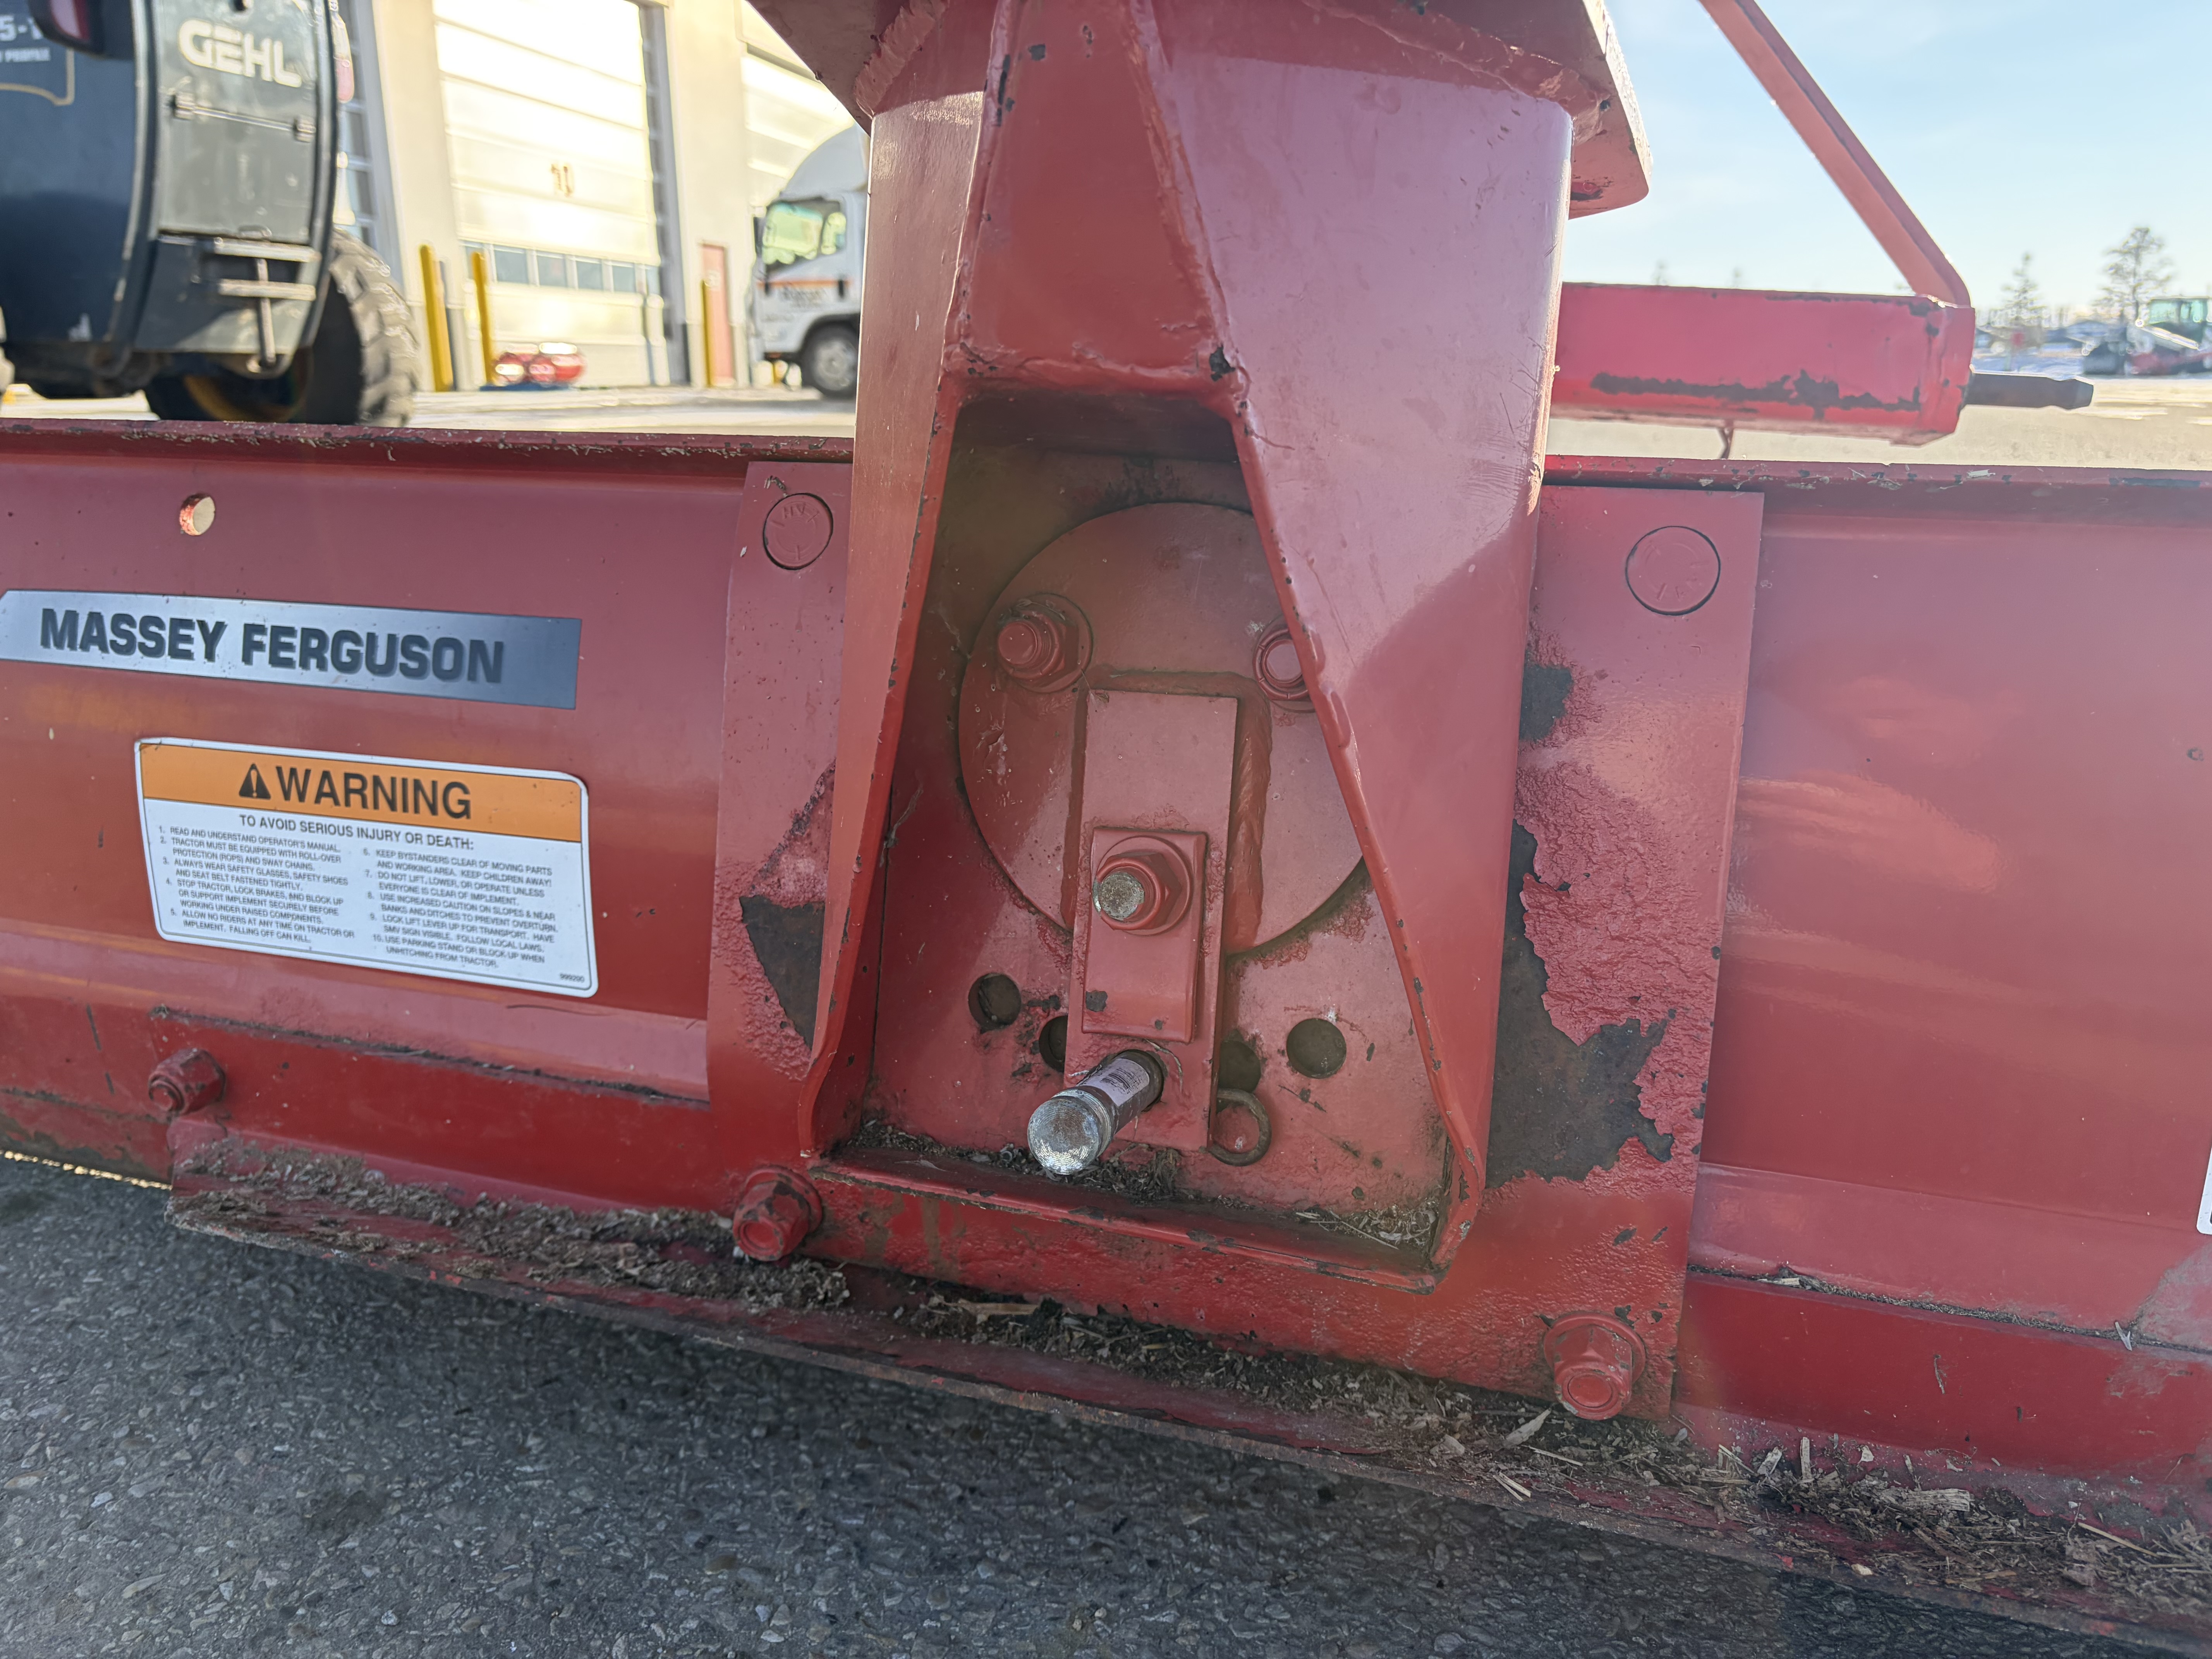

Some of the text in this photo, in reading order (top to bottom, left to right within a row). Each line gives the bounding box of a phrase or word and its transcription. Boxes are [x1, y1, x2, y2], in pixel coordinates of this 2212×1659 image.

[178, 19, 302, 88] GEHL
[40, 608, 505, 684] MASSEY FERGUSON
[275, 765, 471, 820] WARNING
[159, 825, 340, 852] 1. READ AND UNDERSTAND OPERATOR'S MANUAL.
[240, 814, 473, 850] TO AVOID SERIOUS INJURY OR DEATH:
[171, 836, 204, 848] TRACTOR
[206, 840, 226, 850] MUST
[228, 843, 238, 852] BE
[239, 844, 276, 856] EQUIPPED
[278, 848, 297, 858] WITH
[298, 851, 341, 863] ROLL-OVER
[172, 847, 314, 871] PROTECTION (ROPS) AND SWAY CHAINS.
[376, 848, 396, 859] KEEP
[397, 851, 449, 864] BYSTANDERS
[450, 857, 477, 867] CLEAR
[478, 860, 489, 869] OF
[491, 862, 524, 872] MOVING
[525, 865, 552, 876] PARTS
[174, 858, 203, 868] ALWAYS
[204, 861, 226, 871] WEAR
[227, 864, 254, 874] SAFETY
[256, 867, 291, 879] GLASSES,
[293, 871, 320, 882] SAFETY
[322, 875, 348, 885] SHOES
[175, 868, 302, 891] AND SEAT BELT FASTENED TIGHTLY.
[365, 869, 372, 878] 7.
[378, 871, 390, 879] DO
[390, 872, 407, 881] NOT
[460, 880, 473, 889] OR
[474, 882, 510, 893] OPERATE
[512, 886, 544, 897] UNLESS
[376, 860, 393, 869] AND
[395, 862, 432, 873] WORKING
[460, 869, 481, 879] KEEP
[483, 872, 524, 884] CHILDREN
[525, 877, 551, 886] AWAY!
[177, 878, 196, 888] STOP
[198, 881, 232, 893] TRACTOR,
[234, 885, 254, 895] LOCK
[256, 888, 287, 899] BRAKES,
[288, 892, 304, 901] AND
[306, 894, 331, 904] BLOCK
[333, 897, 343, 906] UP
[178, 888, 338, 915] OR SUPPORT IMPLEMENT SECURELY BEFORE
[378, 881, 419, 893] EVERYONE
[421, 887, 429, 895] IS
[430, 888, 456, 898] CLEAR
[457, 891, 468, 900] OF
[180, 899, 322, 924] WORKING UNDER RAISED COMPONENTS.
[380, 893, 395, 902] USE
[397, 895, 441, 907] INCREASED
[442, 900, 477, 911] CAUTION
[479, 905, 491, 913] ON
[492, 906, 524, 917] SLOPES
[532, 911, 555, 921] NEAR
[380, 903, 407, 914] BANKS
[409, 907, 426, 916] AND
[427, 909, 460, 920] DITCHES
[462, 913, 473, 922] TO
[474, 915, 510, 926] PREVENT
[182, 909, 206, 919] ALLOW
[207, 912, 218, 921] NO
[220, 914, 246, 924] RIDERS
[247, 917, 256, 926] AT
[258, 919, 273, 927] ANY
[275, 921, 292, 930] TIME
[294, 923, 305, 932] ON
[307, 925, 342, 936] TRACTOR
[343, 929, 354, 938] OR
[183, 919, 311, 943] IMPLEMENT. FALLING OFF CAN KILL.
[382, 914, 404, 924] LOCK
[405, 917, 420, 926] LIFT
[422, 919, 447, 929] LEVER
[448, 922, 460, 931] UP
[460, 924, 477, 933] FOR
[532, 933, 554, 943] HAVE
[383, 924, 400, 934] SMV
[402, 927, 420, 936] SIGN
[455, 934, 489, 945] FOLLOW
[491, 938, 516, 949] LOCAL
[373, 933, 544, 963] 10. USE PARKING STAND OR BLOCK UP WHEN
[386, 946, 433, 959] UNHITCHING
[434, 952, 458, 962] FROM
